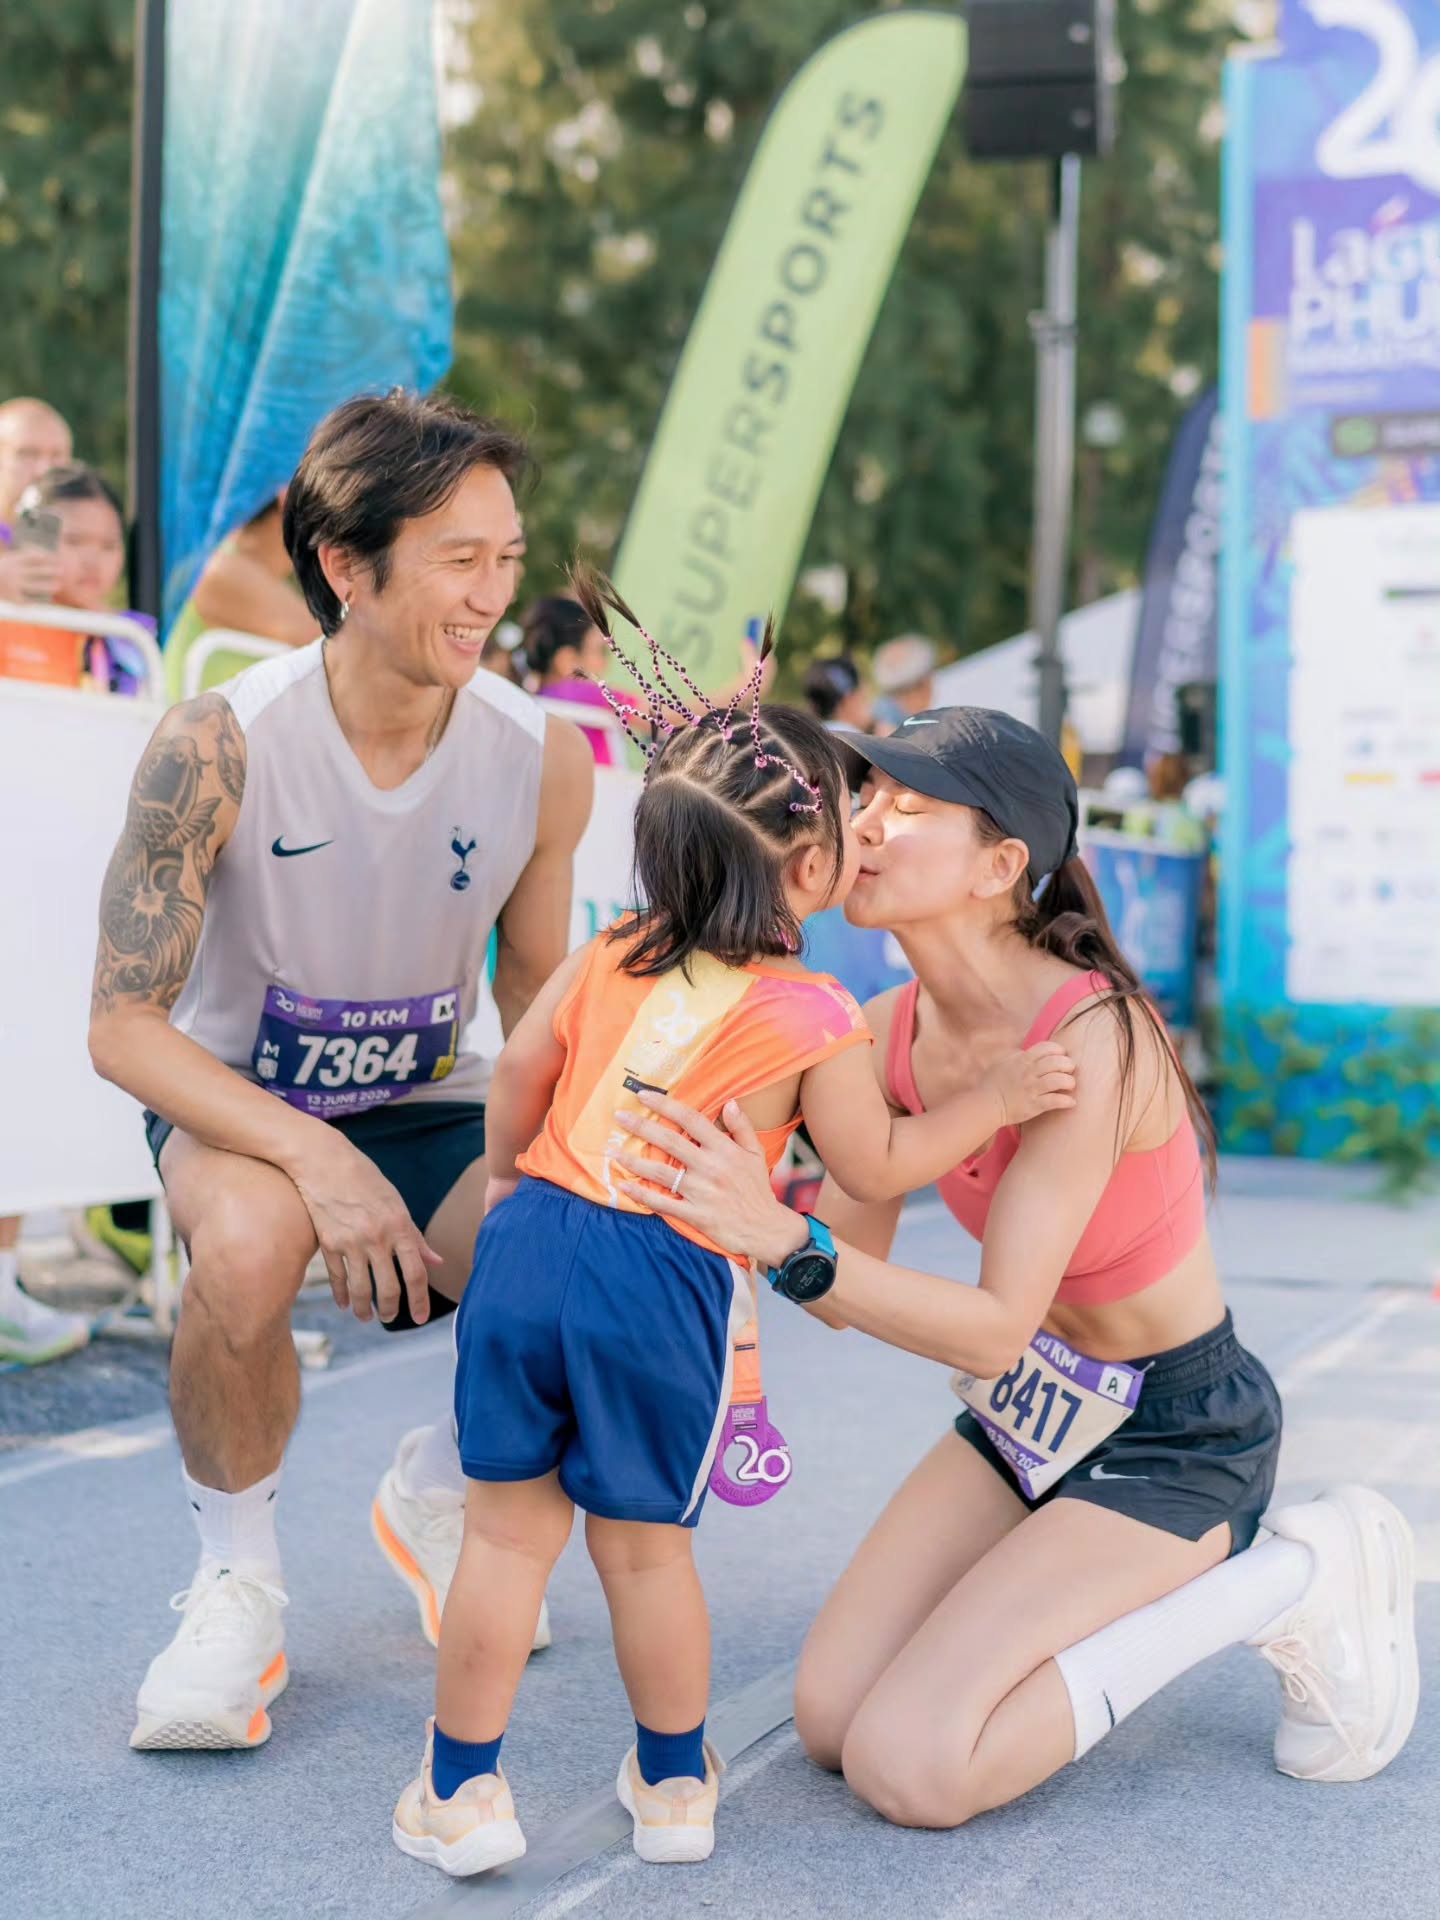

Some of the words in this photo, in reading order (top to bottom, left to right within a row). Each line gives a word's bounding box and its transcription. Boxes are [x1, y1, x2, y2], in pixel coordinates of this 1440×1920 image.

[660, 88, 888, 670] SUPERSPORTS
[341, 1010, 367, 1028] 10
[370, 1007, 410, 1027] KM
[262, 1040, 280, 1059] M
[293, 1033, 419, 1088] 7364
[306, 1093, 321, 1106] 13
[322, 1091, 358, 1106] JUNE
[1050, 1341, 1083, 1375] KM
[1106, 1376, 1118, 1395] A
[990, 1356, 1083, 1453] 8417
[733, 1434, 792, 1484] 20
